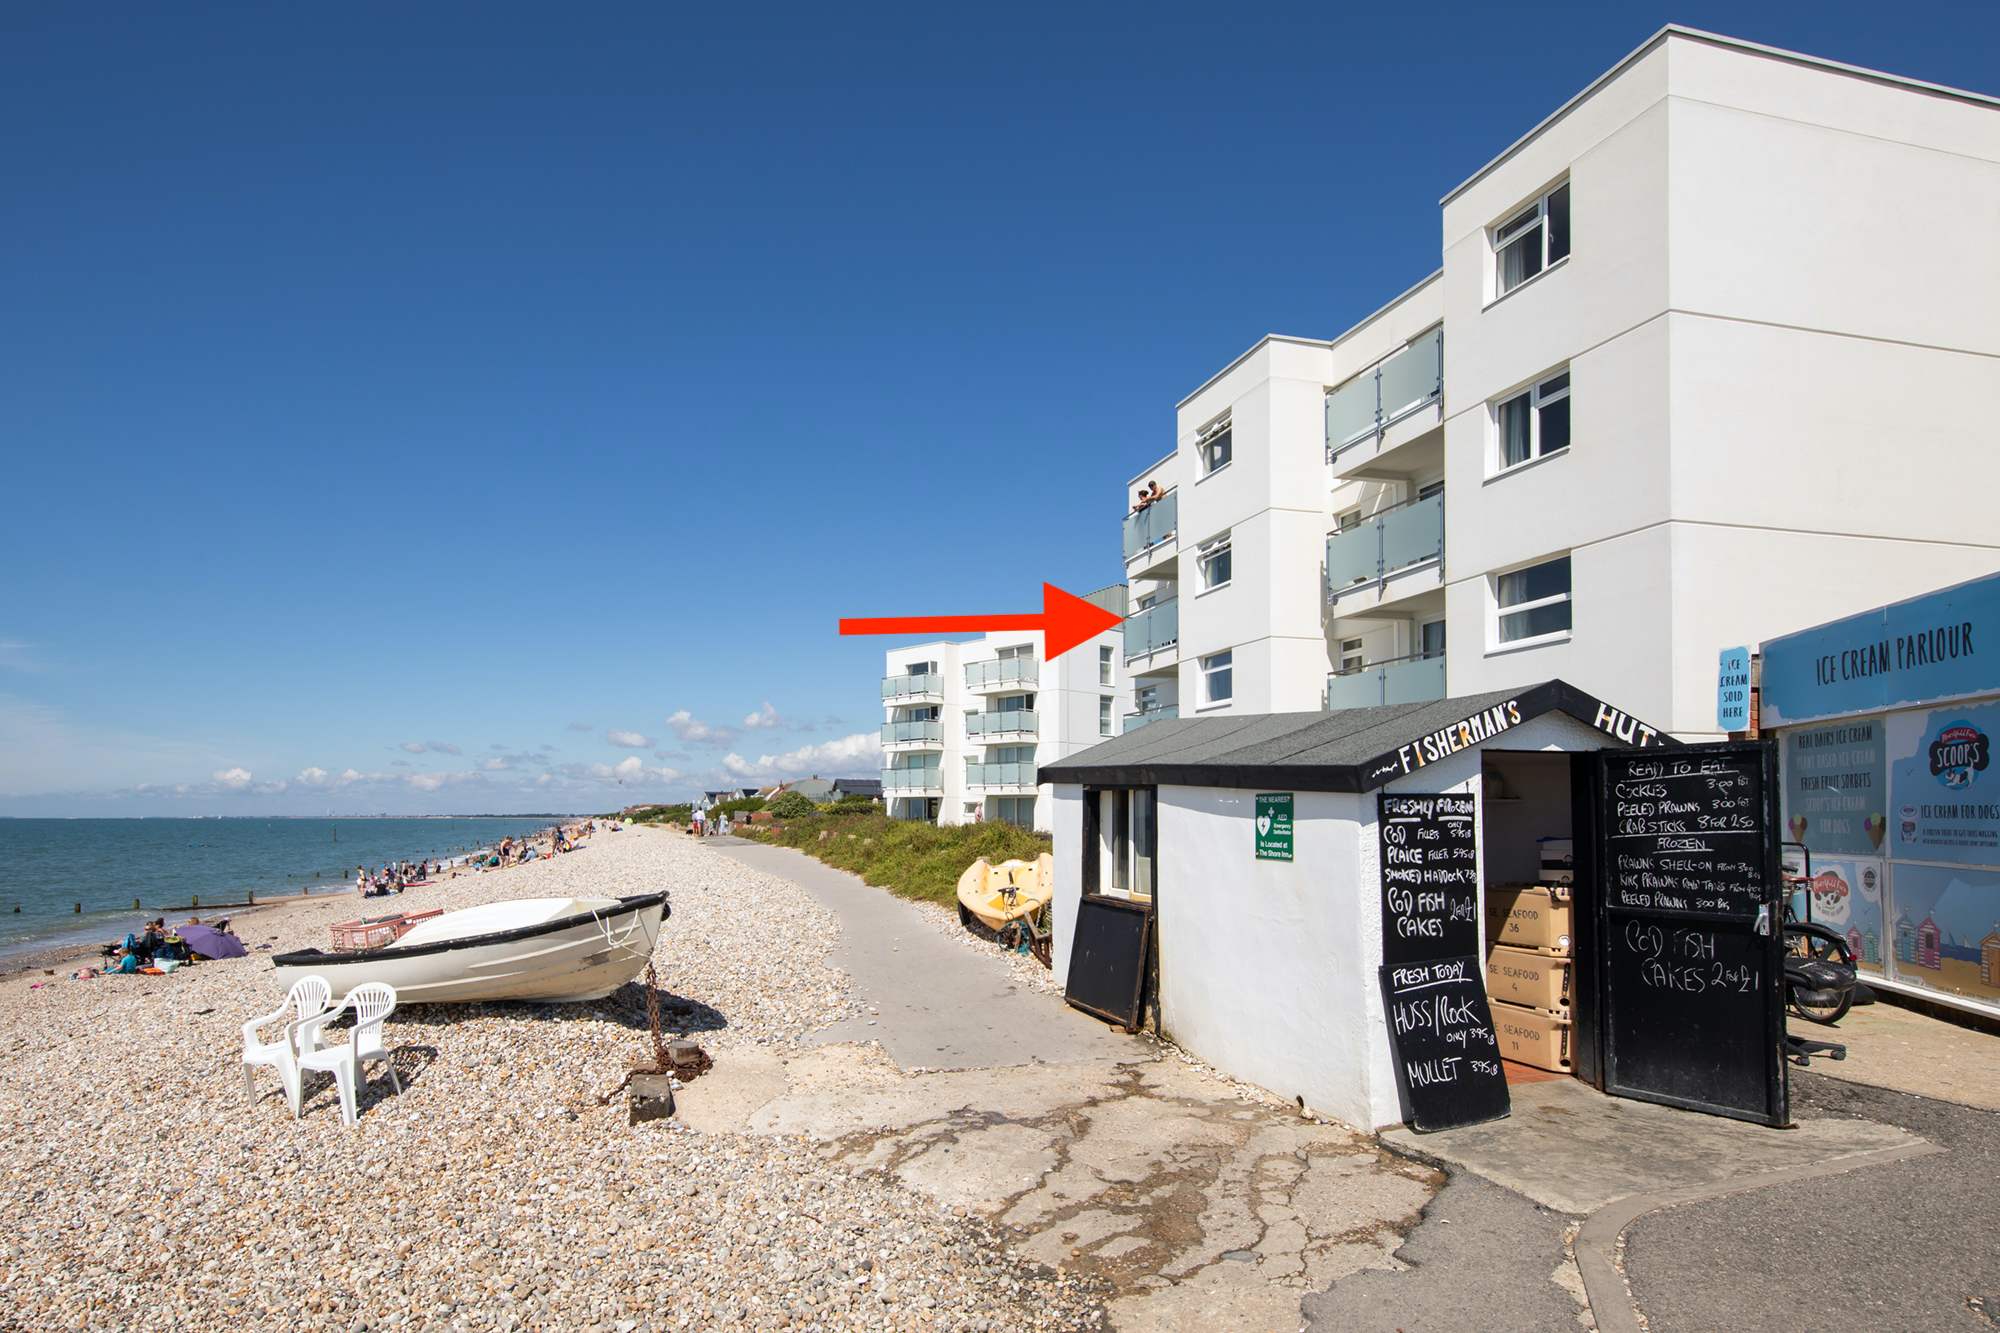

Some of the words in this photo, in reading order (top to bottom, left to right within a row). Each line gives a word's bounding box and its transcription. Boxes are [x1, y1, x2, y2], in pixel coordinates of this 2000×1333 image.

[1816, 655, 1837, 686] ICE
[1841, 639, 1891, 681] CREAM
[1895, 622, 1974, 670] PARLOUR
[1727, 658, 1741, 671] ICE
[1720, 673, 1748, 688] CREAM
[1723, 690, 1743, 703] SOLD
[1722, 706, 1743, 719] HERE
[1398, 700, 1521, 774] FISHERMAN'S
[1593, 702, 1657, 747] HUT
[1814, 731, 1834, 748] DAIRY
[1836, 729, 1848, 745] ICE
[1849, 724, 1873, 743] CREAM
[1937, 742, 1980, 768] SCOOP'S
[1670, 760, 1692, 775] TO
[1800, 776, 1820, 791] FRESH
[1821, 774, 1840, 790] FRUIT
[1841, 772, 1872, 788] SORBETS
[1617, 801, 1654, 817] PEELED
[1658, 800, 1701, 814] PRAWNS
[1920, 804, 1931, 819] ICE
[1934, 804, 1959, 819] CREAM
[1961, 804, 1976, 819] FOR
[1978, 804, 2000, 820] DOGS
[1697, 815, 1710, 829] 8
[1710, 815, 1726, 829] FOR
[1265, 840, 1282, 848] Located
[1657, 837, 1706, 850] FROZEN
[1259, 849, 1268, 857] The
[1268, 849, 1281, 858] Shore
[1281, 850, 1289, 858] Inn
[1618, 854, 1655, 870] PRAWNS
[1417, 891, 1445, 912] FISH
[1621, 890, 1650, 907] PEELED
[1654, 891, 1688, 910] PRAWNS
[1397, 916, 1444, 938] CAKES
[1508, 922, 1520, 933] 36
[1625, 919, 1664, 958] COD
[1392, 966, 1430, 988] FRESH
[1431, 960, 1465, 984] TODAY
[1503, 966, 1540, 981] SEAFOOD
[1641, 957, 1706, 993] CAKES
[1446, 1029, 1467, 1049] ONLY
[1503, 1023, 1541, 1041] SEAFOOD
[1407, 1056, 1462, 1089] MULLET
